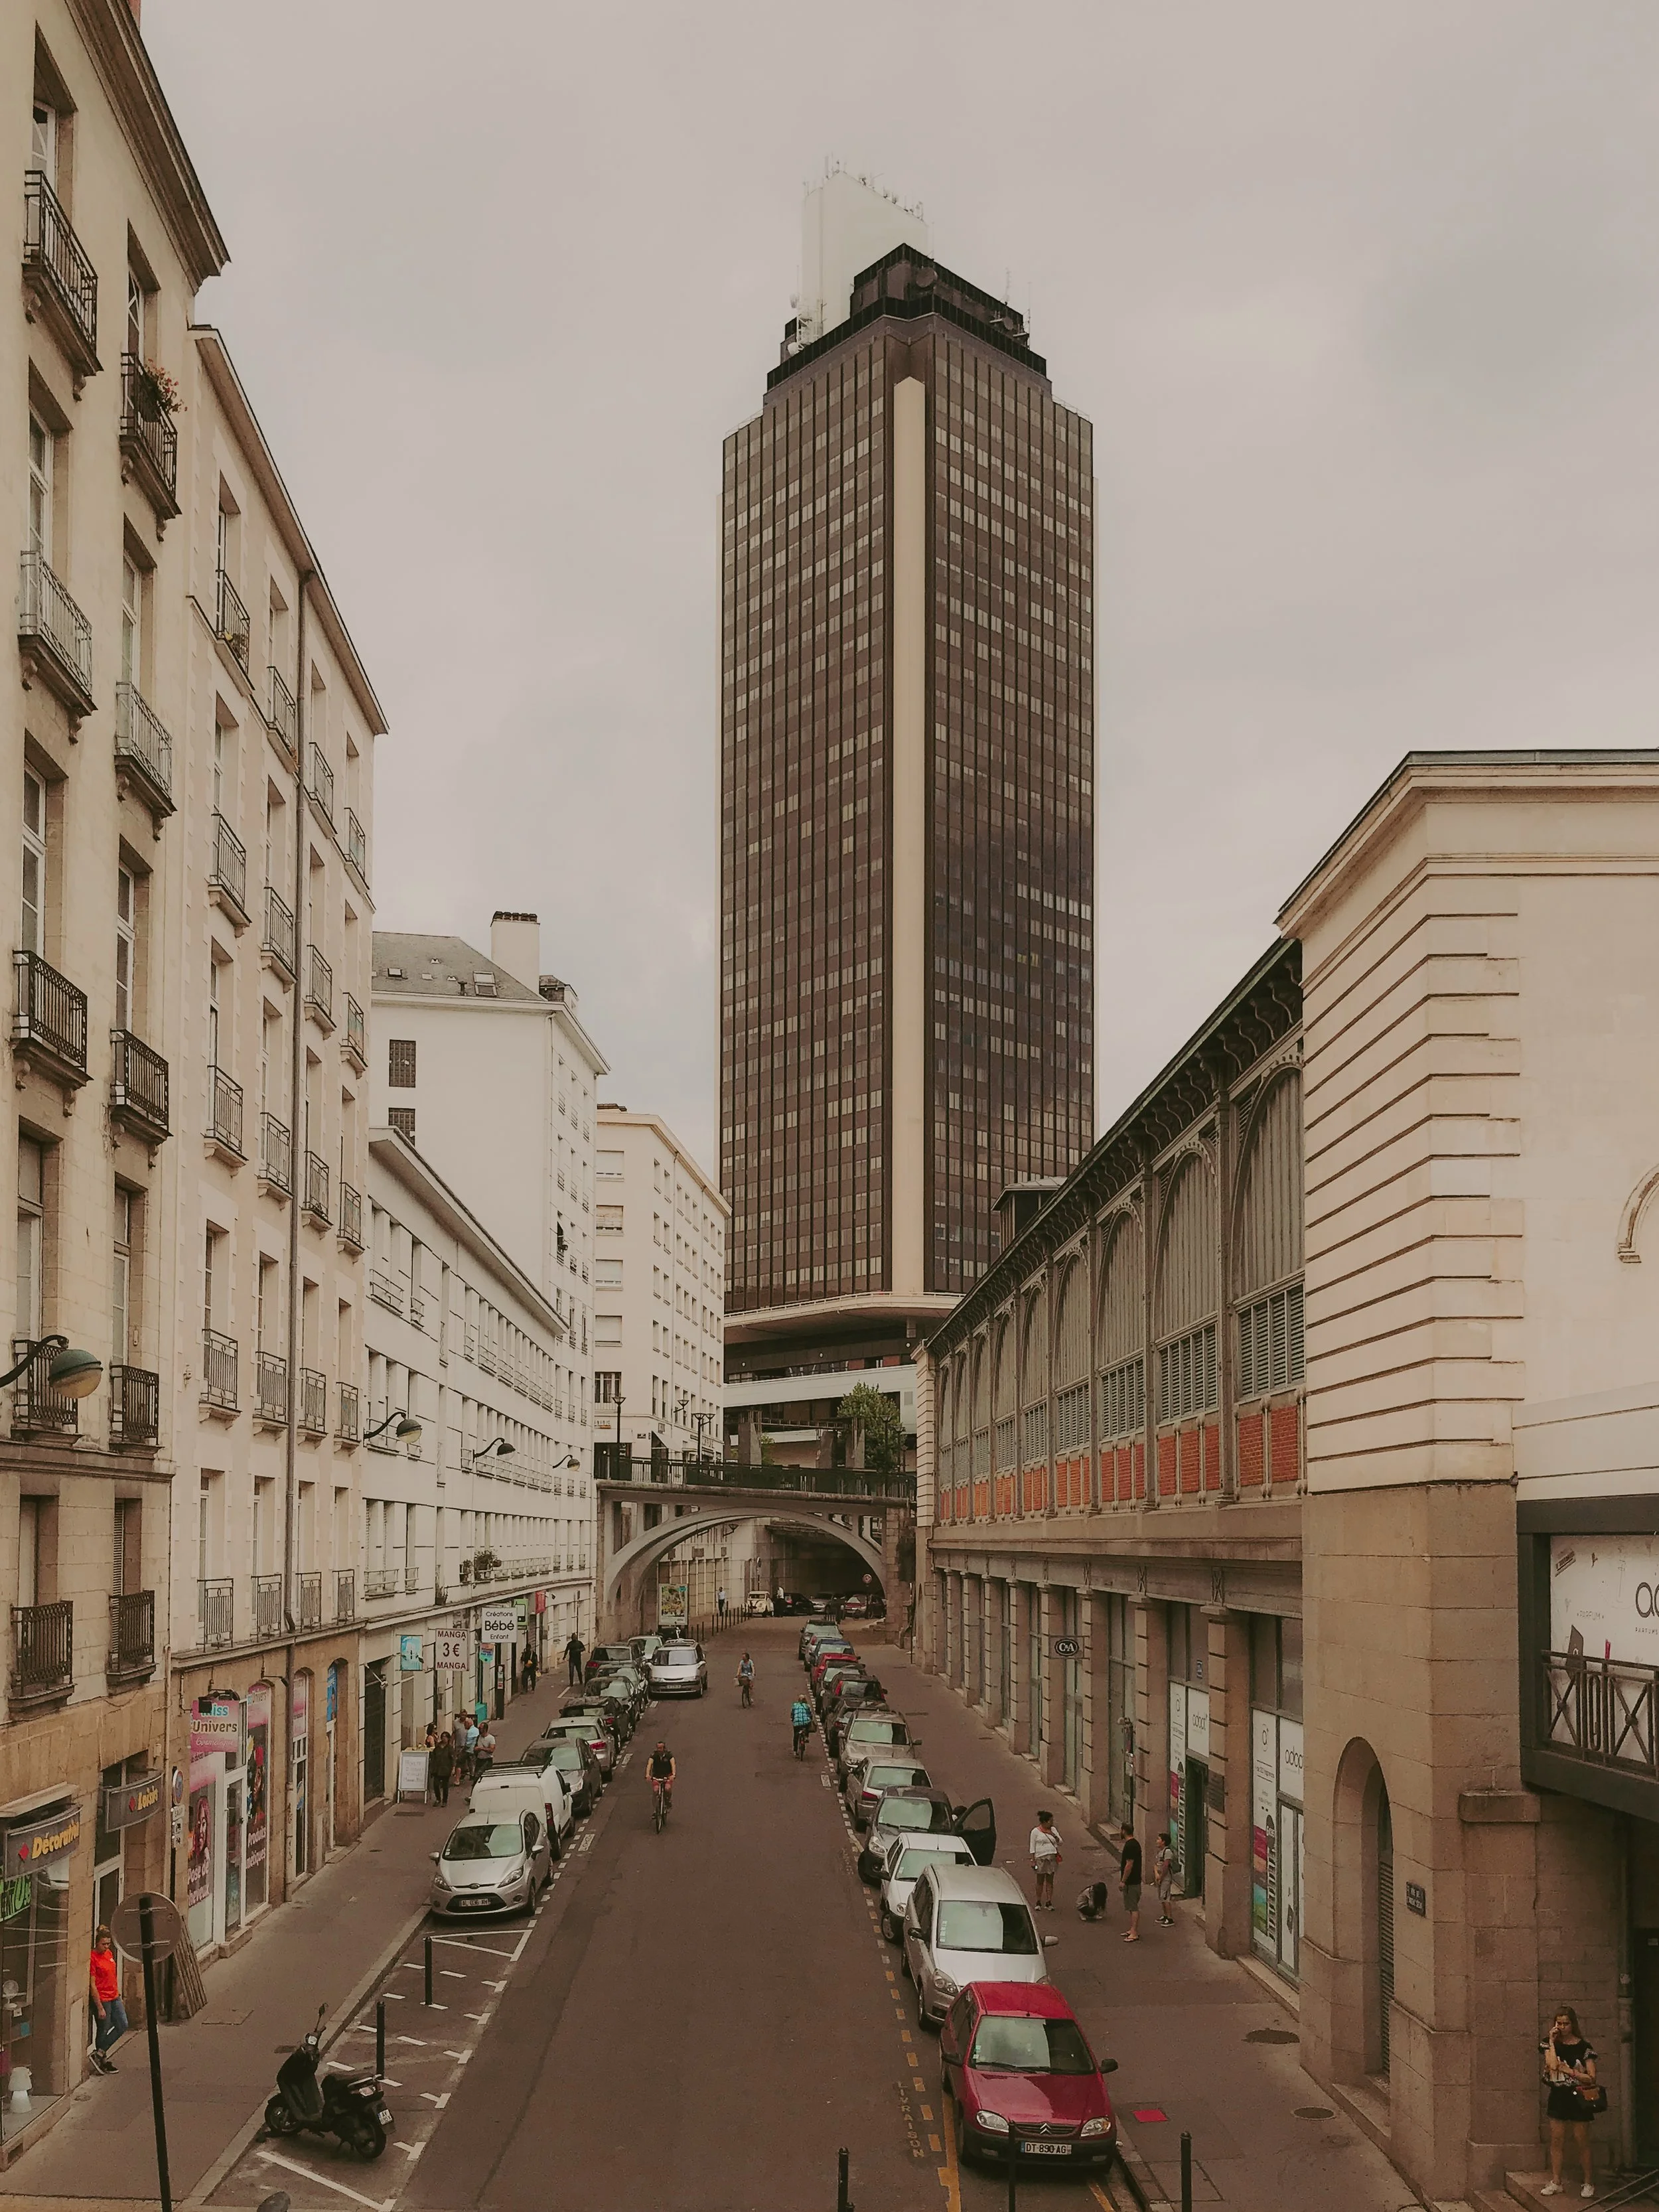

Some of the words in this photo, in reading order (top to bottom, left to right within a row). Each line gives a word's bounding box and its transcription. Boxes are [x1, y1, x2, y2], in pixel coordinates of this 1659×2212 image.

[484, 1620, 514, 1631] Bébé
[437, 1630, 467, 1639] MANGA
[443, 1642, 450, 1657] 3
[453, 1643, 460, 1657] €
[1058, 1643, 1074, 1652] C&A
[201, 1704, 228, 1716] iss
[193, 1720, 238, 1733] Univers
[1285, 1745, 1304, 1775] adop
[187, 1864, 201, 1885] Pose
[187, 1884, 210, 1907] heveux
